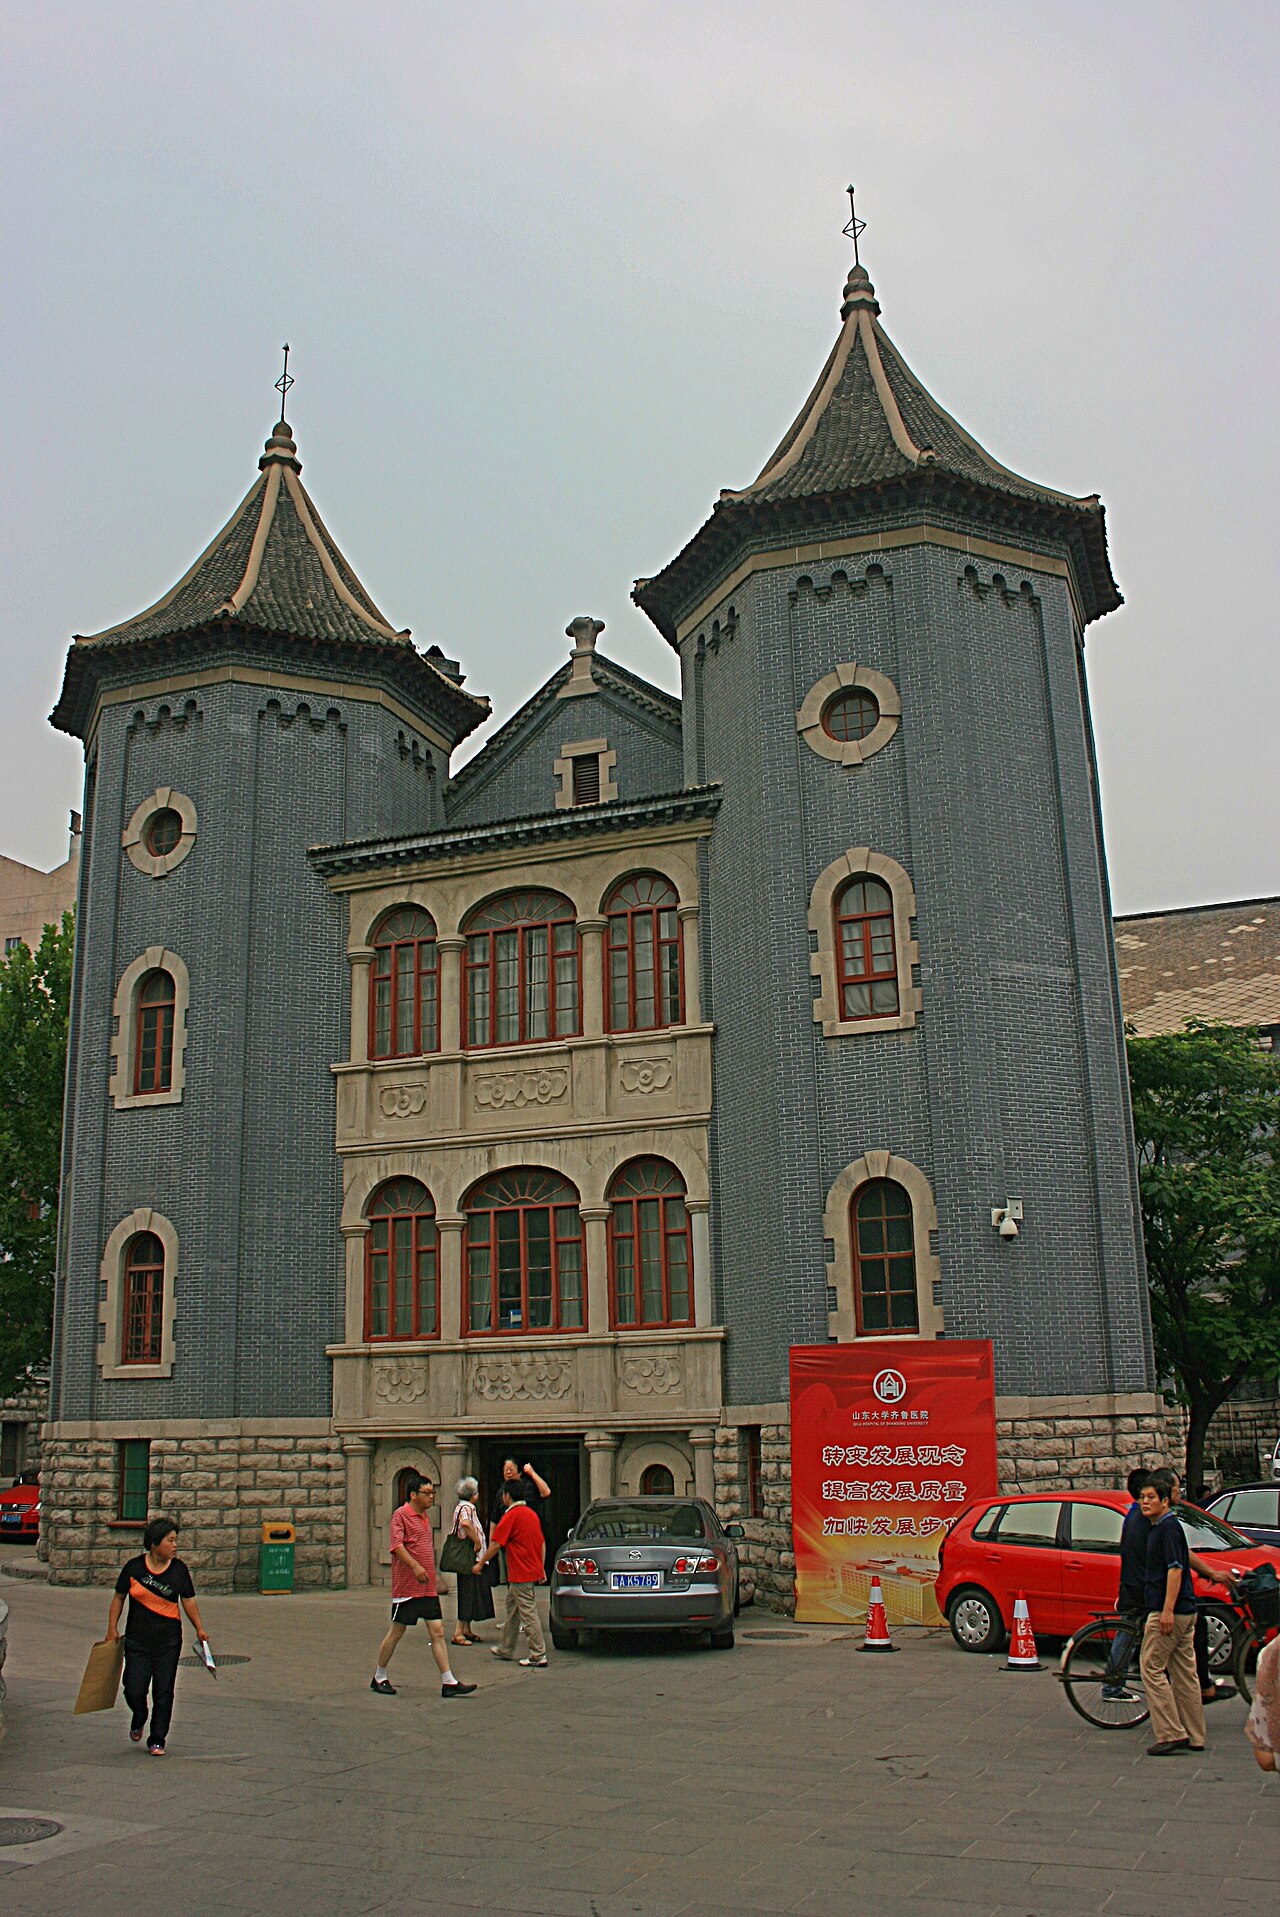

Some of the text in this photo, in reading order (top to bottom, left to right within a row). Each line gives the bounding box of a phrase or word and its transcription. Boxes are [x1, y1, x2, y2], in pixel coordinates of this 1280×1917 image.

[852, 1410, 929, 1420] 山东大学齐鲁医院
[822, 1444, 967, 1466] 转变发展观念
[822, 1480, 967, 1501] 提高发展质量
